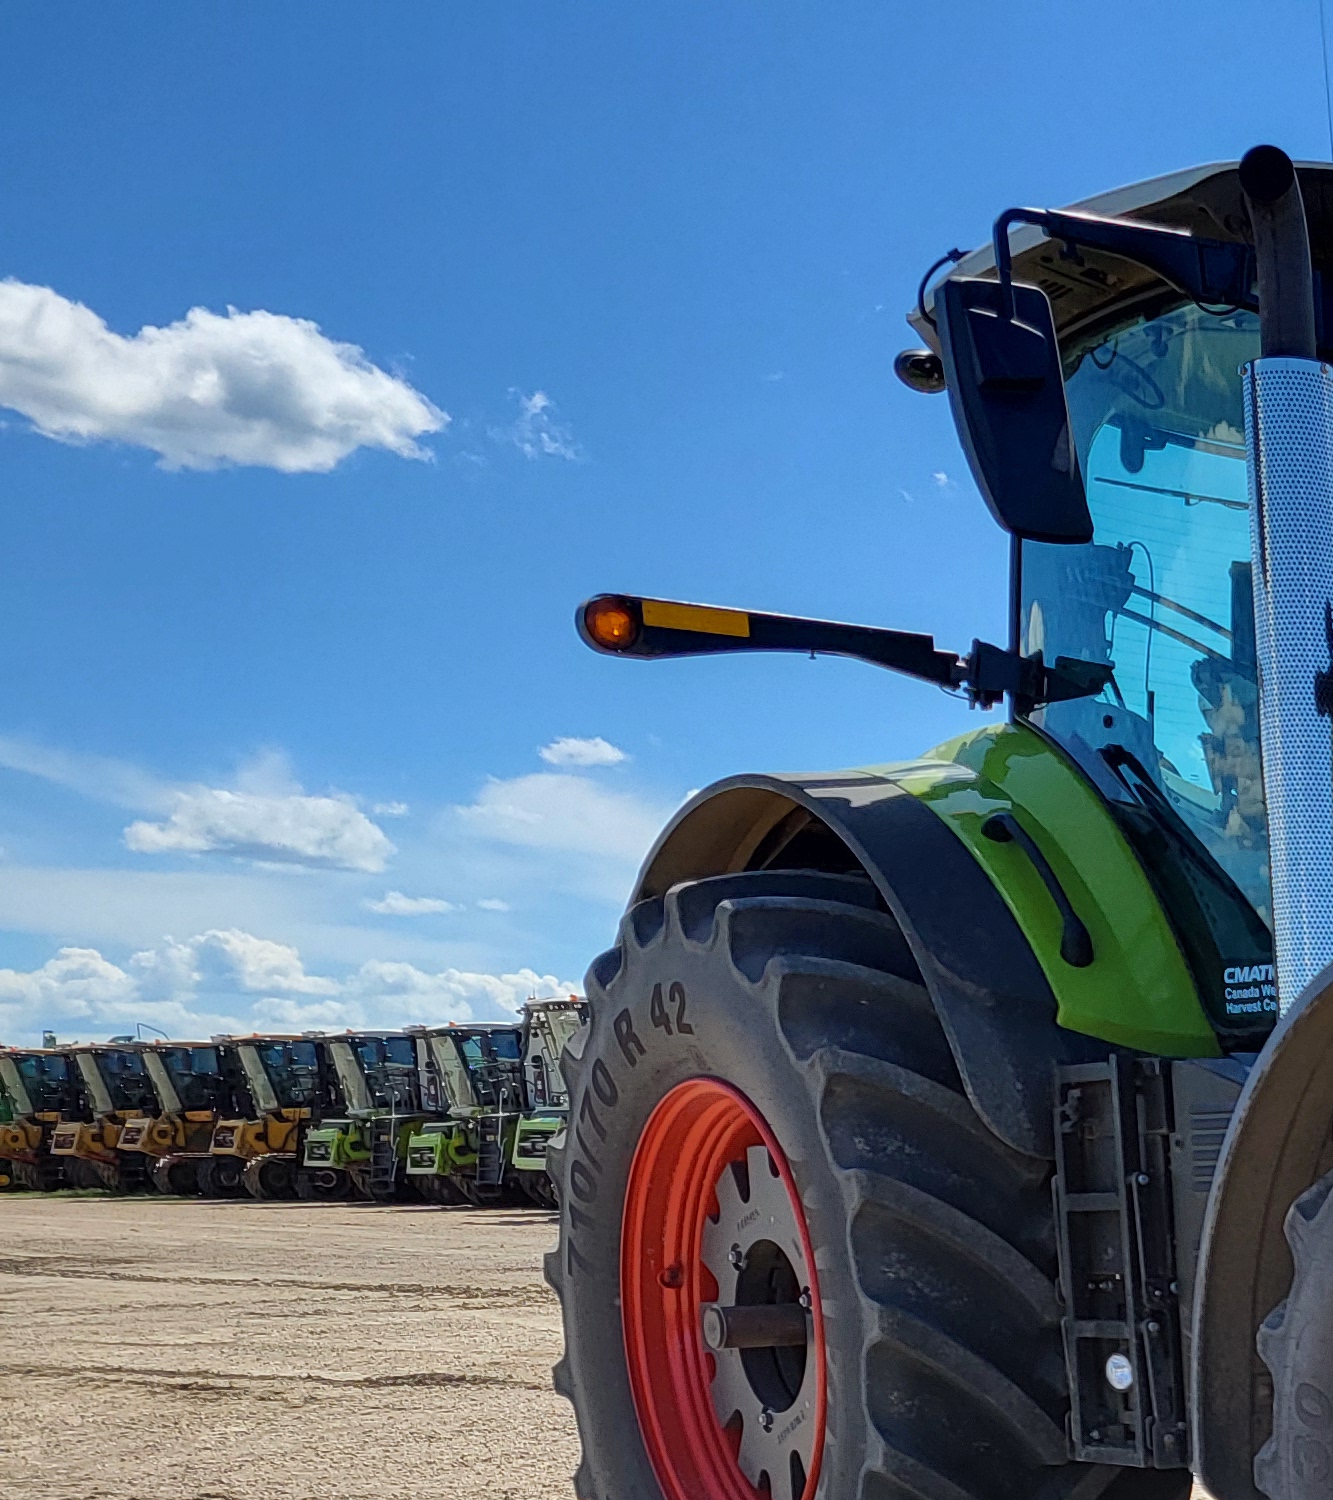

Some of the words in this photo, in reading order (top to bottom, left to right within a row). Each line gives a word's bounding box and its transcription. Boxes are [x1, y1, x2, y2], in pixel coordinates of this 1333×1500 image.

[1224, 986, 1260, 1000] Canada
[1261, 983, 1276, 997] We
[1225, 1000, 1262, 1014] Harvest
[567, 1057, 619, 1278] 710/70
[613, 1007, 647, 1069] R
[650, 981, 695, 1036] 42
